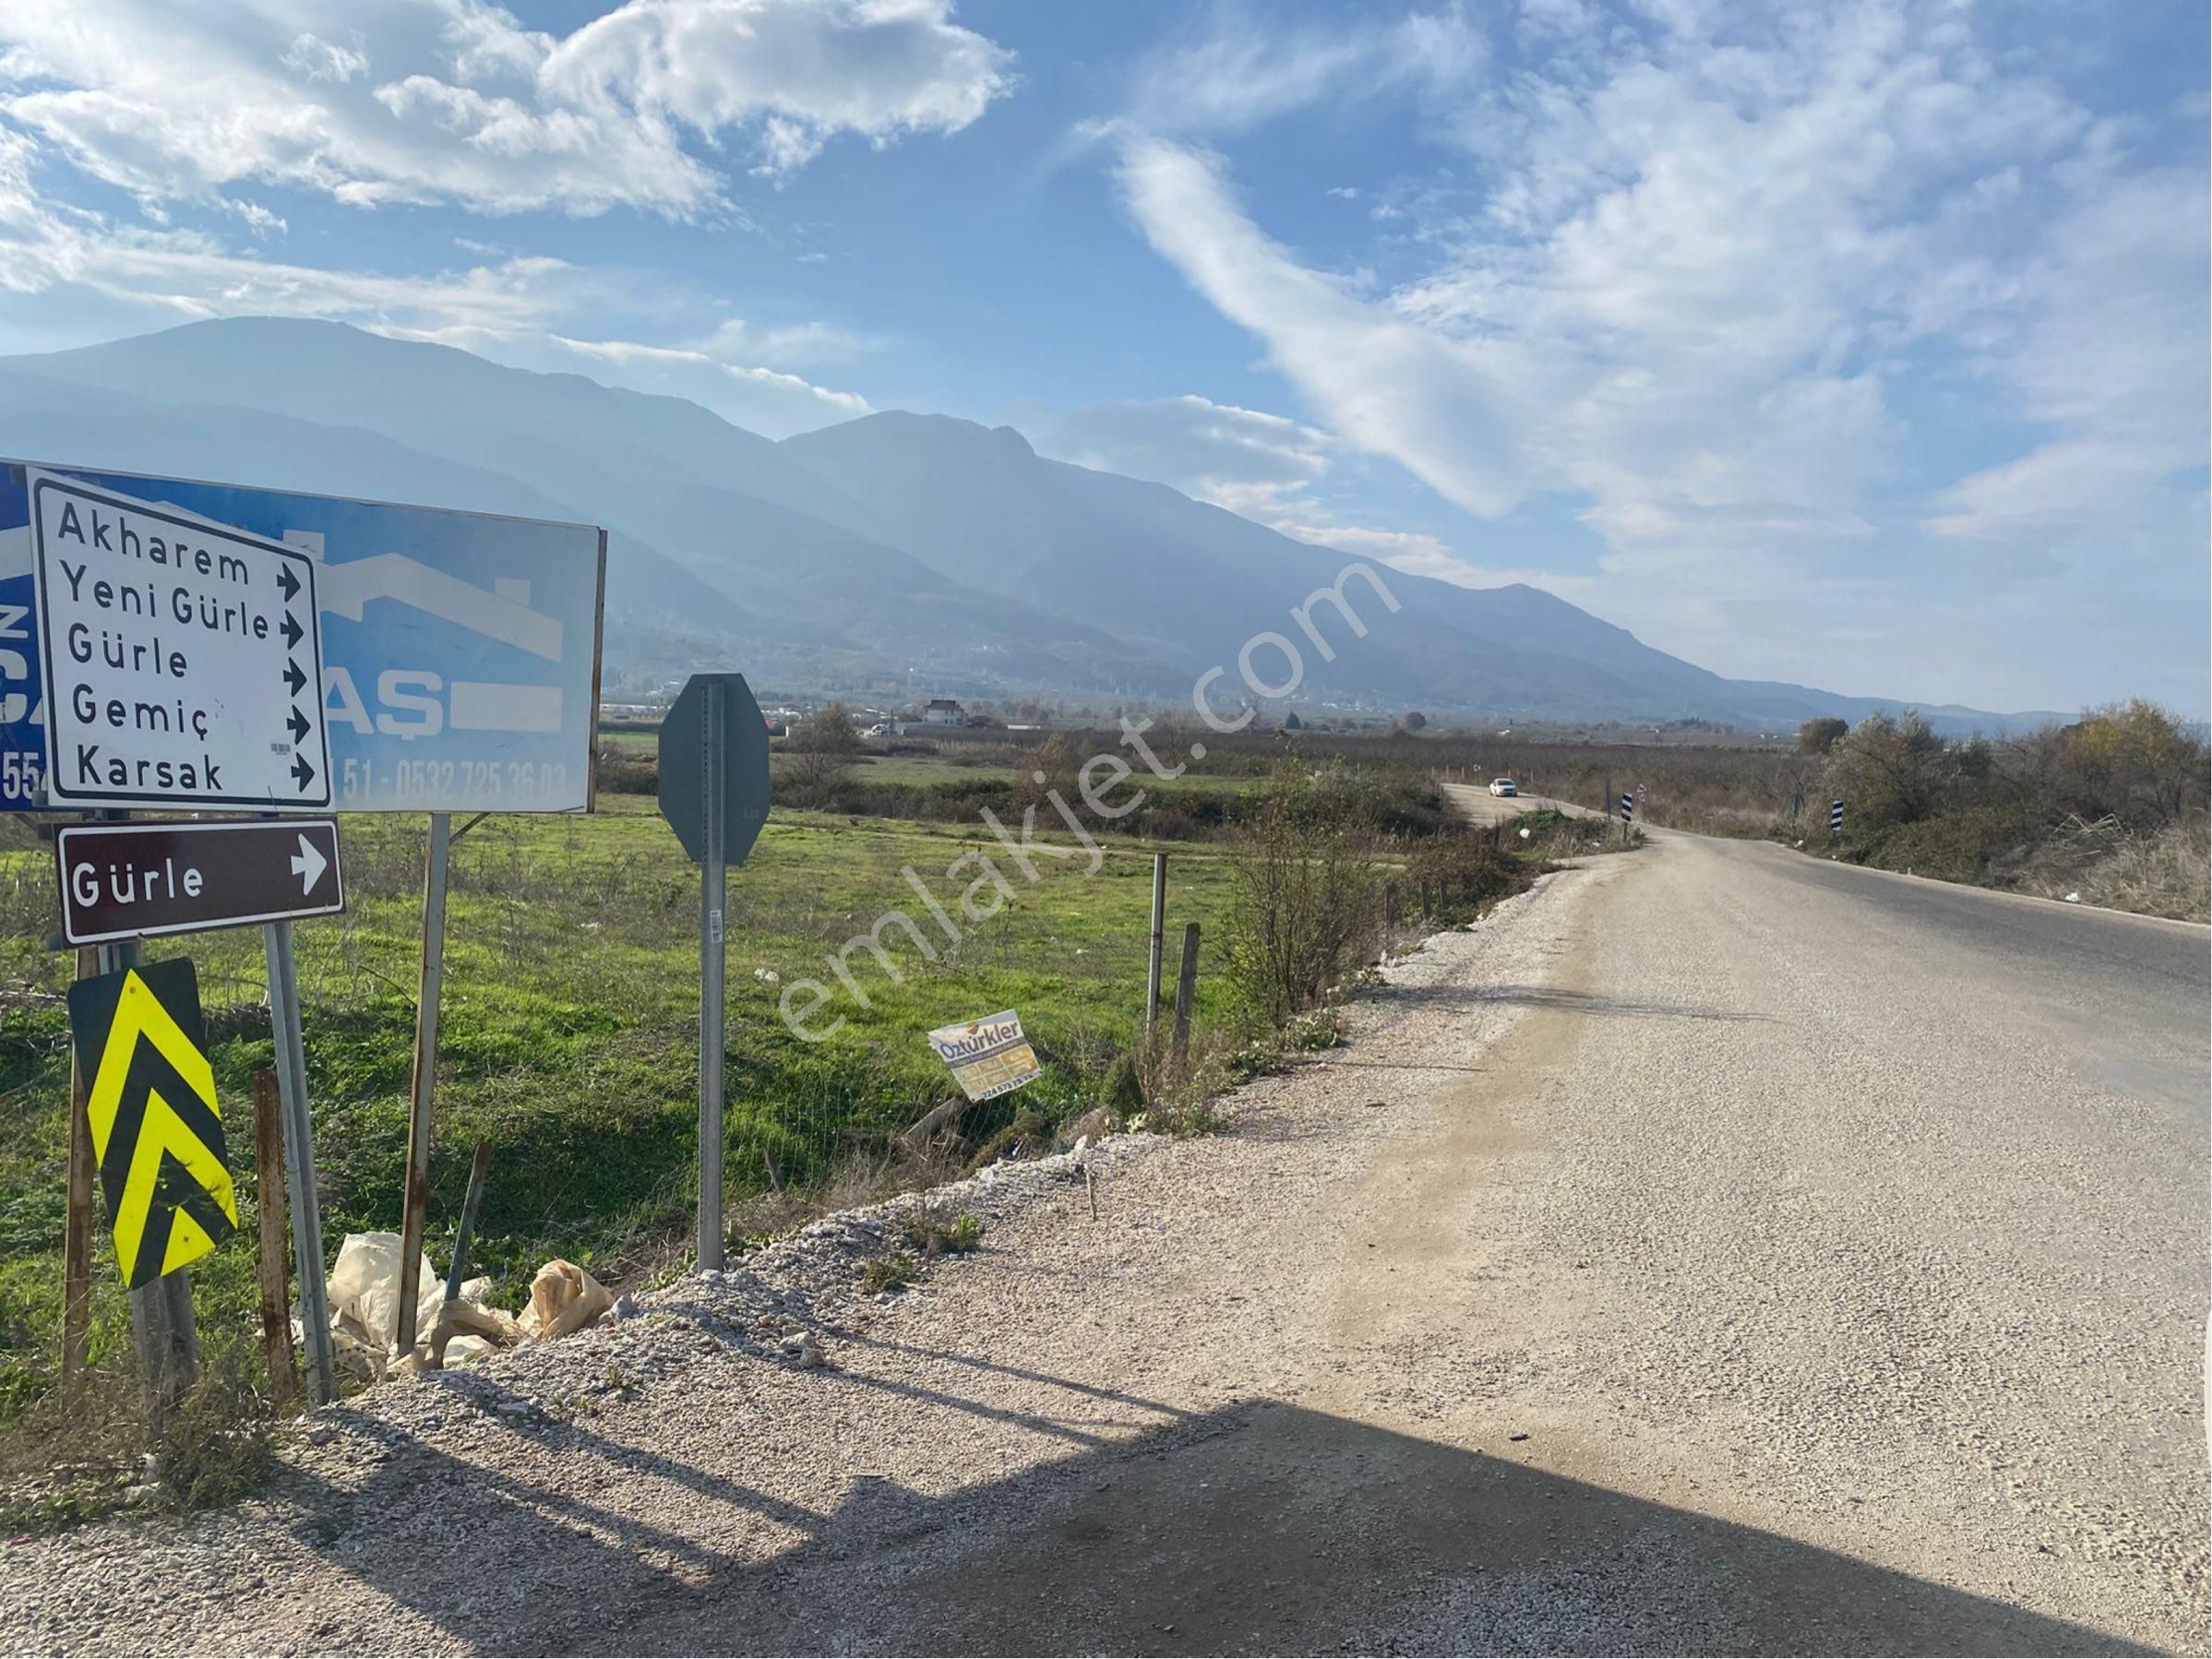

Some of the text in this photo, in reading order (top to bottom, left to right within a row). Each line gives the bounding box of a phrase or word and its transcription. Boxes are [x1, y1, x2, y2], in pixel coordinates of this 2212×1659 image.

[58, 502, 248, 585] Akharem
[60, 559, 269, 639] Yeni Gürle
[68, 623, 187, 678] Gürle
[73, 684, 209, 741] Gemiç
[78, 745, 222, 791] Karsak
[73, 858, 203, 908] Gürle
